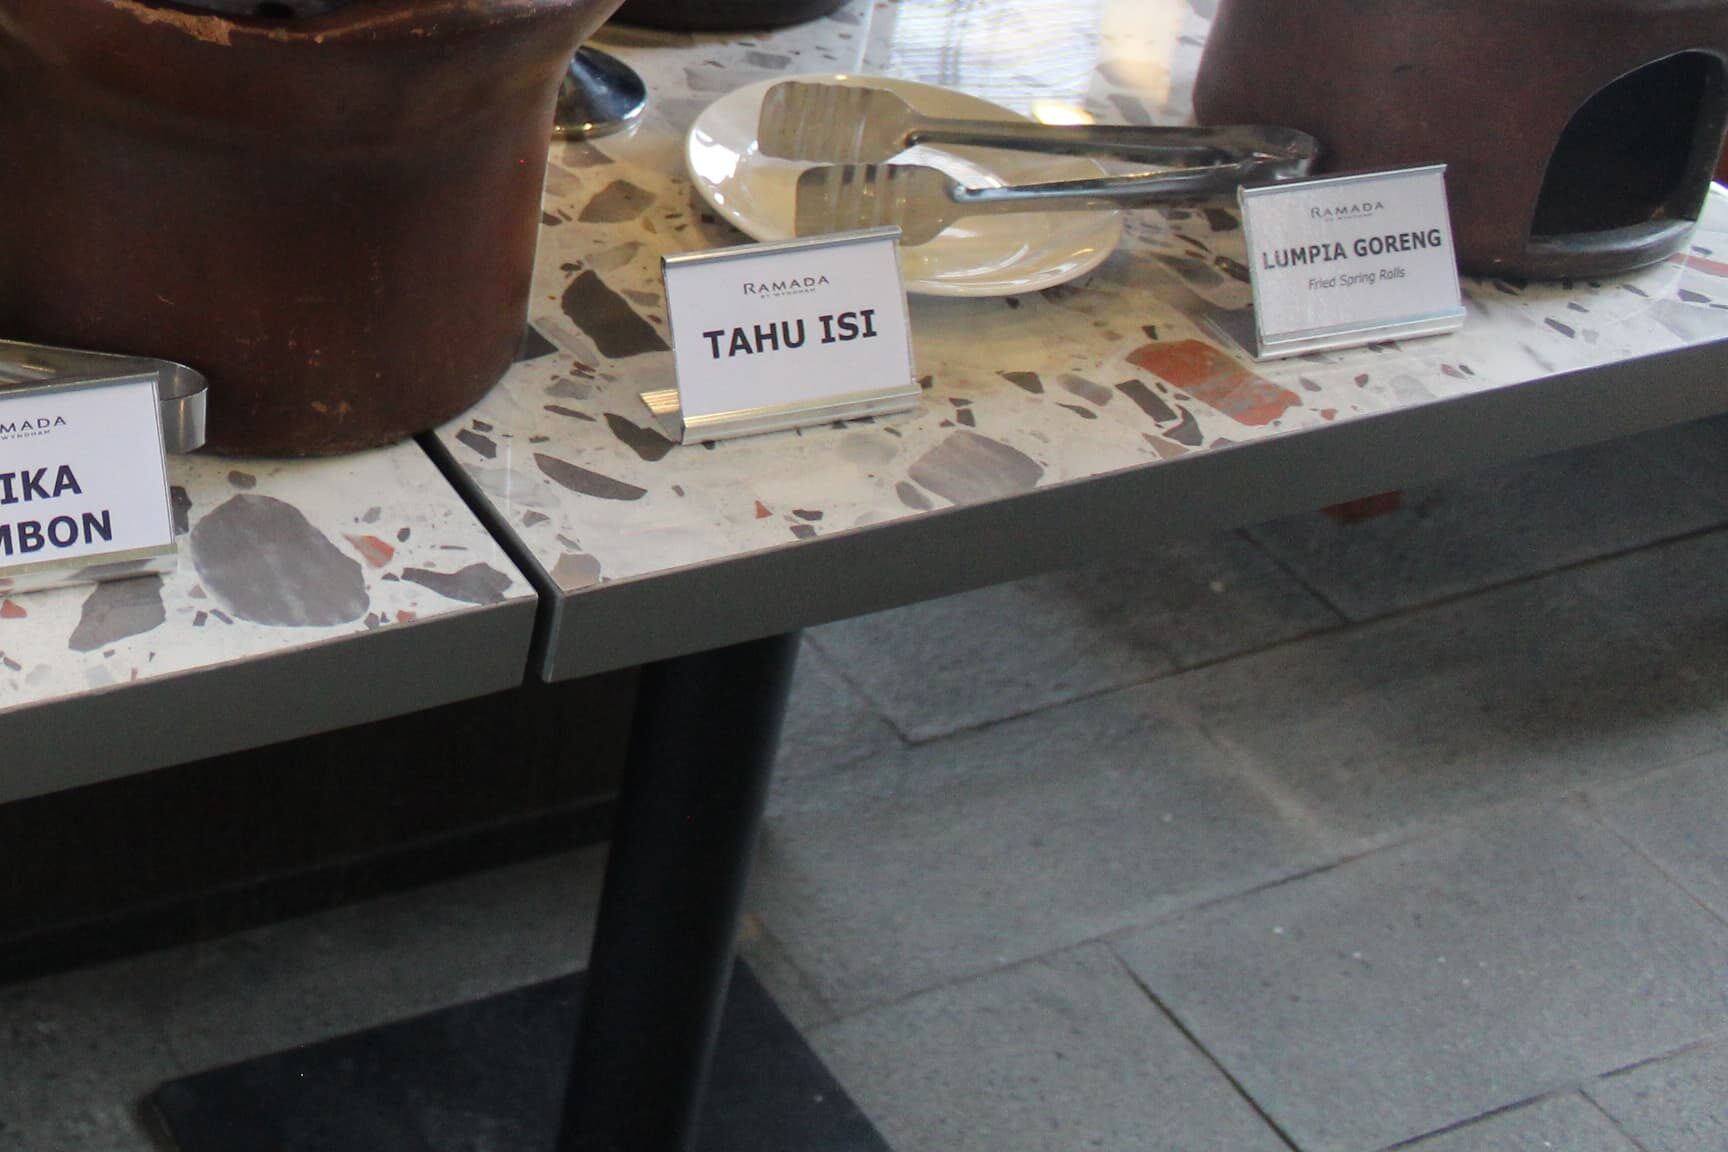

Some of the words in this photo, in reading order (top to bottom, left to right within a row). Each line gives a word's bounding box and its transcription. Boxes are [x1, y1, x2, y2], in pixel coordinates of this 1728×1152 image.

[1310, 201, 1384, 219] RAMADA
[1262, 242, 1347, 270] LUMPIA
[1354, 229, 1442, 257] GORENG
[743, 275, 830, 295] RAMADA
[1308, 277, 1336, 291] Fried
[1340, 273, 1376, 288] Spring
[1379, 266, 1406, 281] Rolls
[703, 319, 805, 359] TAHU
[819, 309, 877, 344] ISI
[1, 429, 51, 440] WYNDHAM
